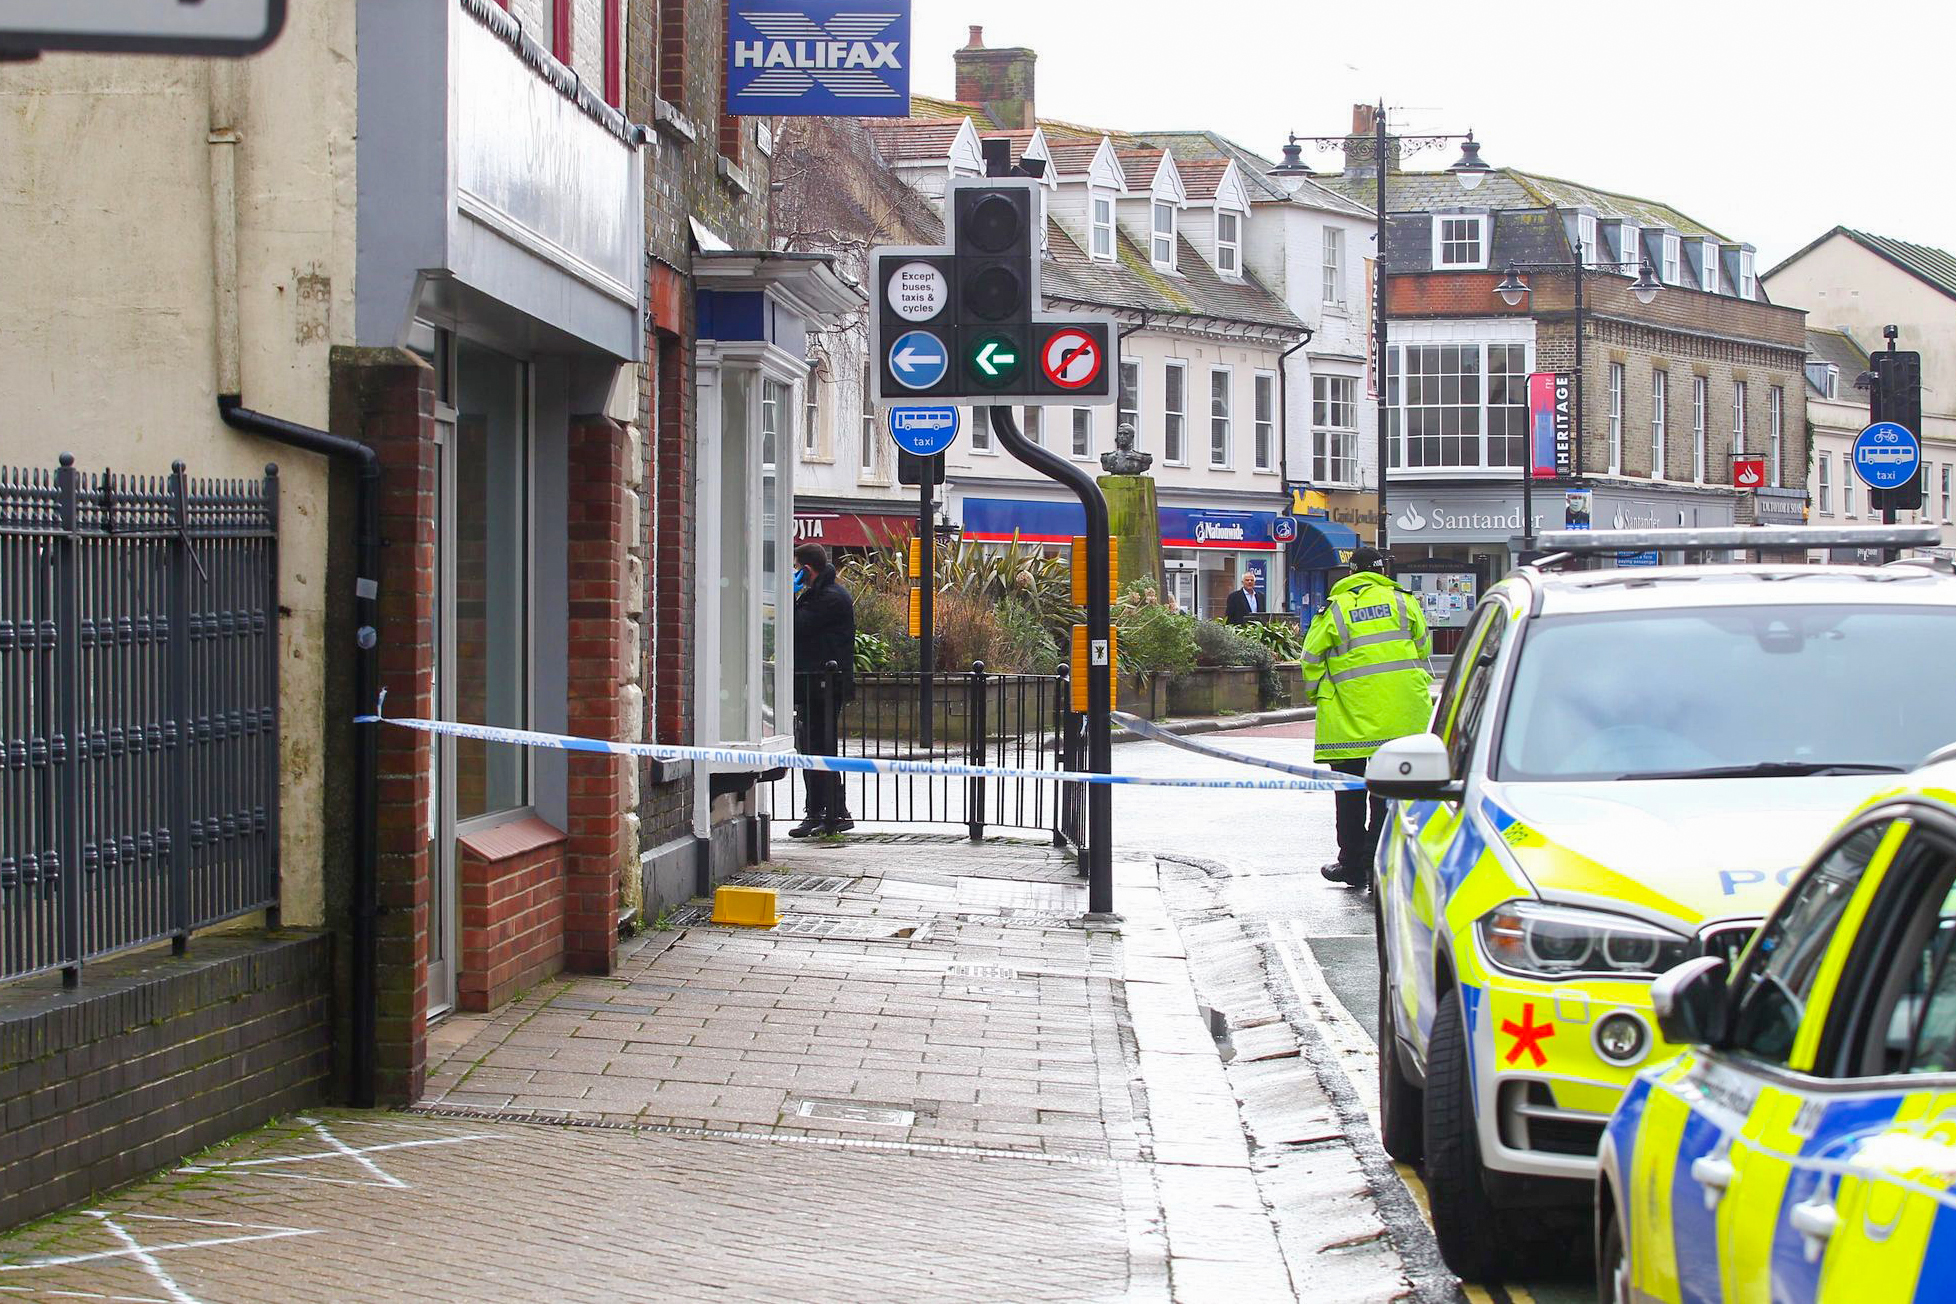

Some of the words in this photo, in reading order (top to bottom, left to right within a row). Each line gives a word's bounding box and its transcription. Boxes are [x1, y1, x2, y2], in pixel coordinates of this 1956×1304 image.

[735, 41, 902, 69] HALIFAX
[902, 272, 934, 281] Except
[902, 283, 934, 292] buses,
[902, 293, 925, 301] taxis
[903, 304, 934, 313] cycles
[1556, 377, 1569, 464] HERITAGE
[914, 437, 934, 446] taxi
[1876, 470, 1896, 480] taxi
[1624, 508, 1660, 529] Santander
[1205, 522, 1244, 540] Nationwide
[1351, 605, 1390, 621] POLICE
[714, 751, 733, 763] DO
[738, 752, 764, 765] NOT
[768, 754, 814, 769] CROSS
